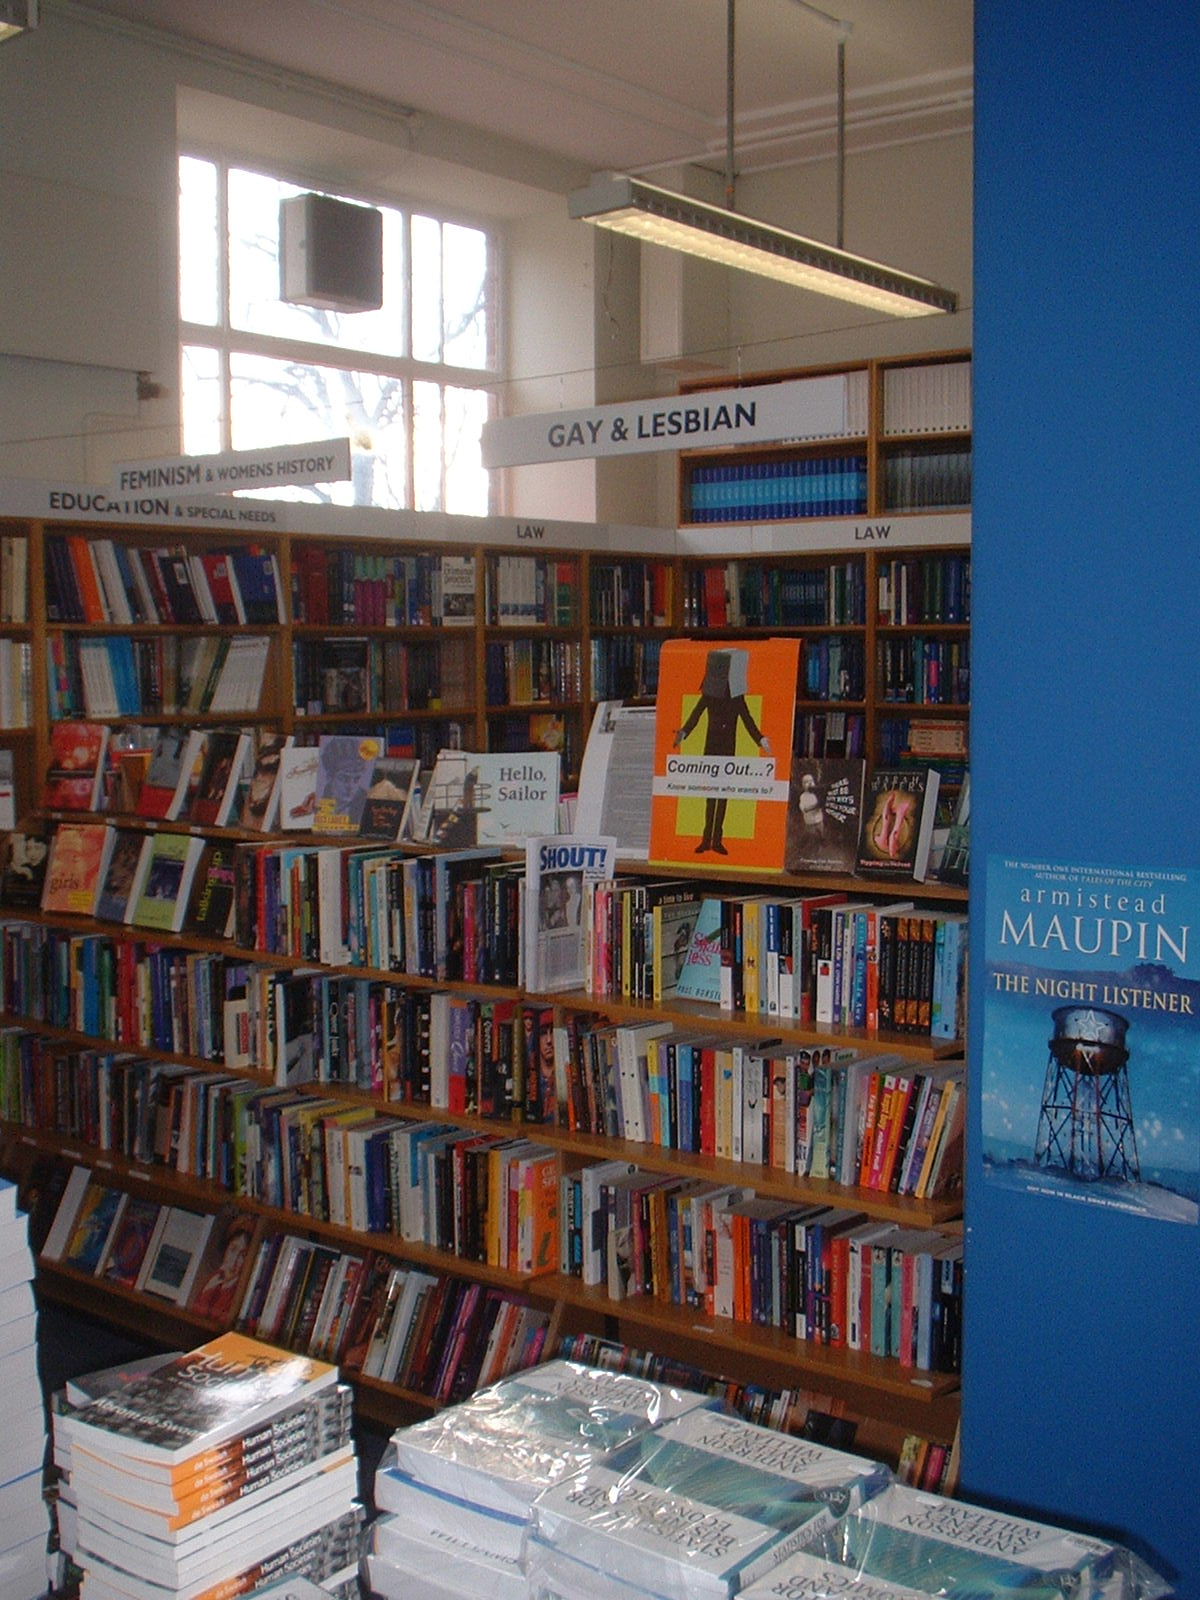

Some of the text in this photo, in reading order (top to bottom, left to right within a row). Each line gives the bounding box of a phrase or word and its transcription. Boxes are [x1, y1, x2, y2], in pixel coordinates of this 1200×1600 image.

[547, 401, 757, 449] GAY & LESBIAN
[119, 456, 335, 492] FEMINISM & WOMENS HISTORY
[175, 506, 184, 517] &
[187, 507, 237, 522] SPECIAL
[238, 509, 277, 523] NEEDS
[516, 525, 545, 540] LAW
[854, 525, 891, 541] LAW
[500, 765, 547, 782] Hello,
[667, 759, 774, 778] Coming Out...?
[498, 785, 548, 801] Sailor
[539, 845, 607, 871] SHOUT!
[1020, 888, 1166, 915] armistead
[999, 909, 1191, 964] MAUPIN
[993, 972, 1194, 1015] THE NIGHT LISTENER
[241, 1428, 273, 1450] Human
[241, 1444, 272, 1467] Human
[701, 1435, 807, 1474] ANDERSON
[246, 1458, 275, 1480] Human
[239, 1474, 270, 1497] Human
[900, 1515, 1028, 1556] ANDERSON
[917, 1510, 1027, 1547] SWEENEY
[260, 1551, 290, 1577] Human
[789, 1574, 845, 1597] AND
